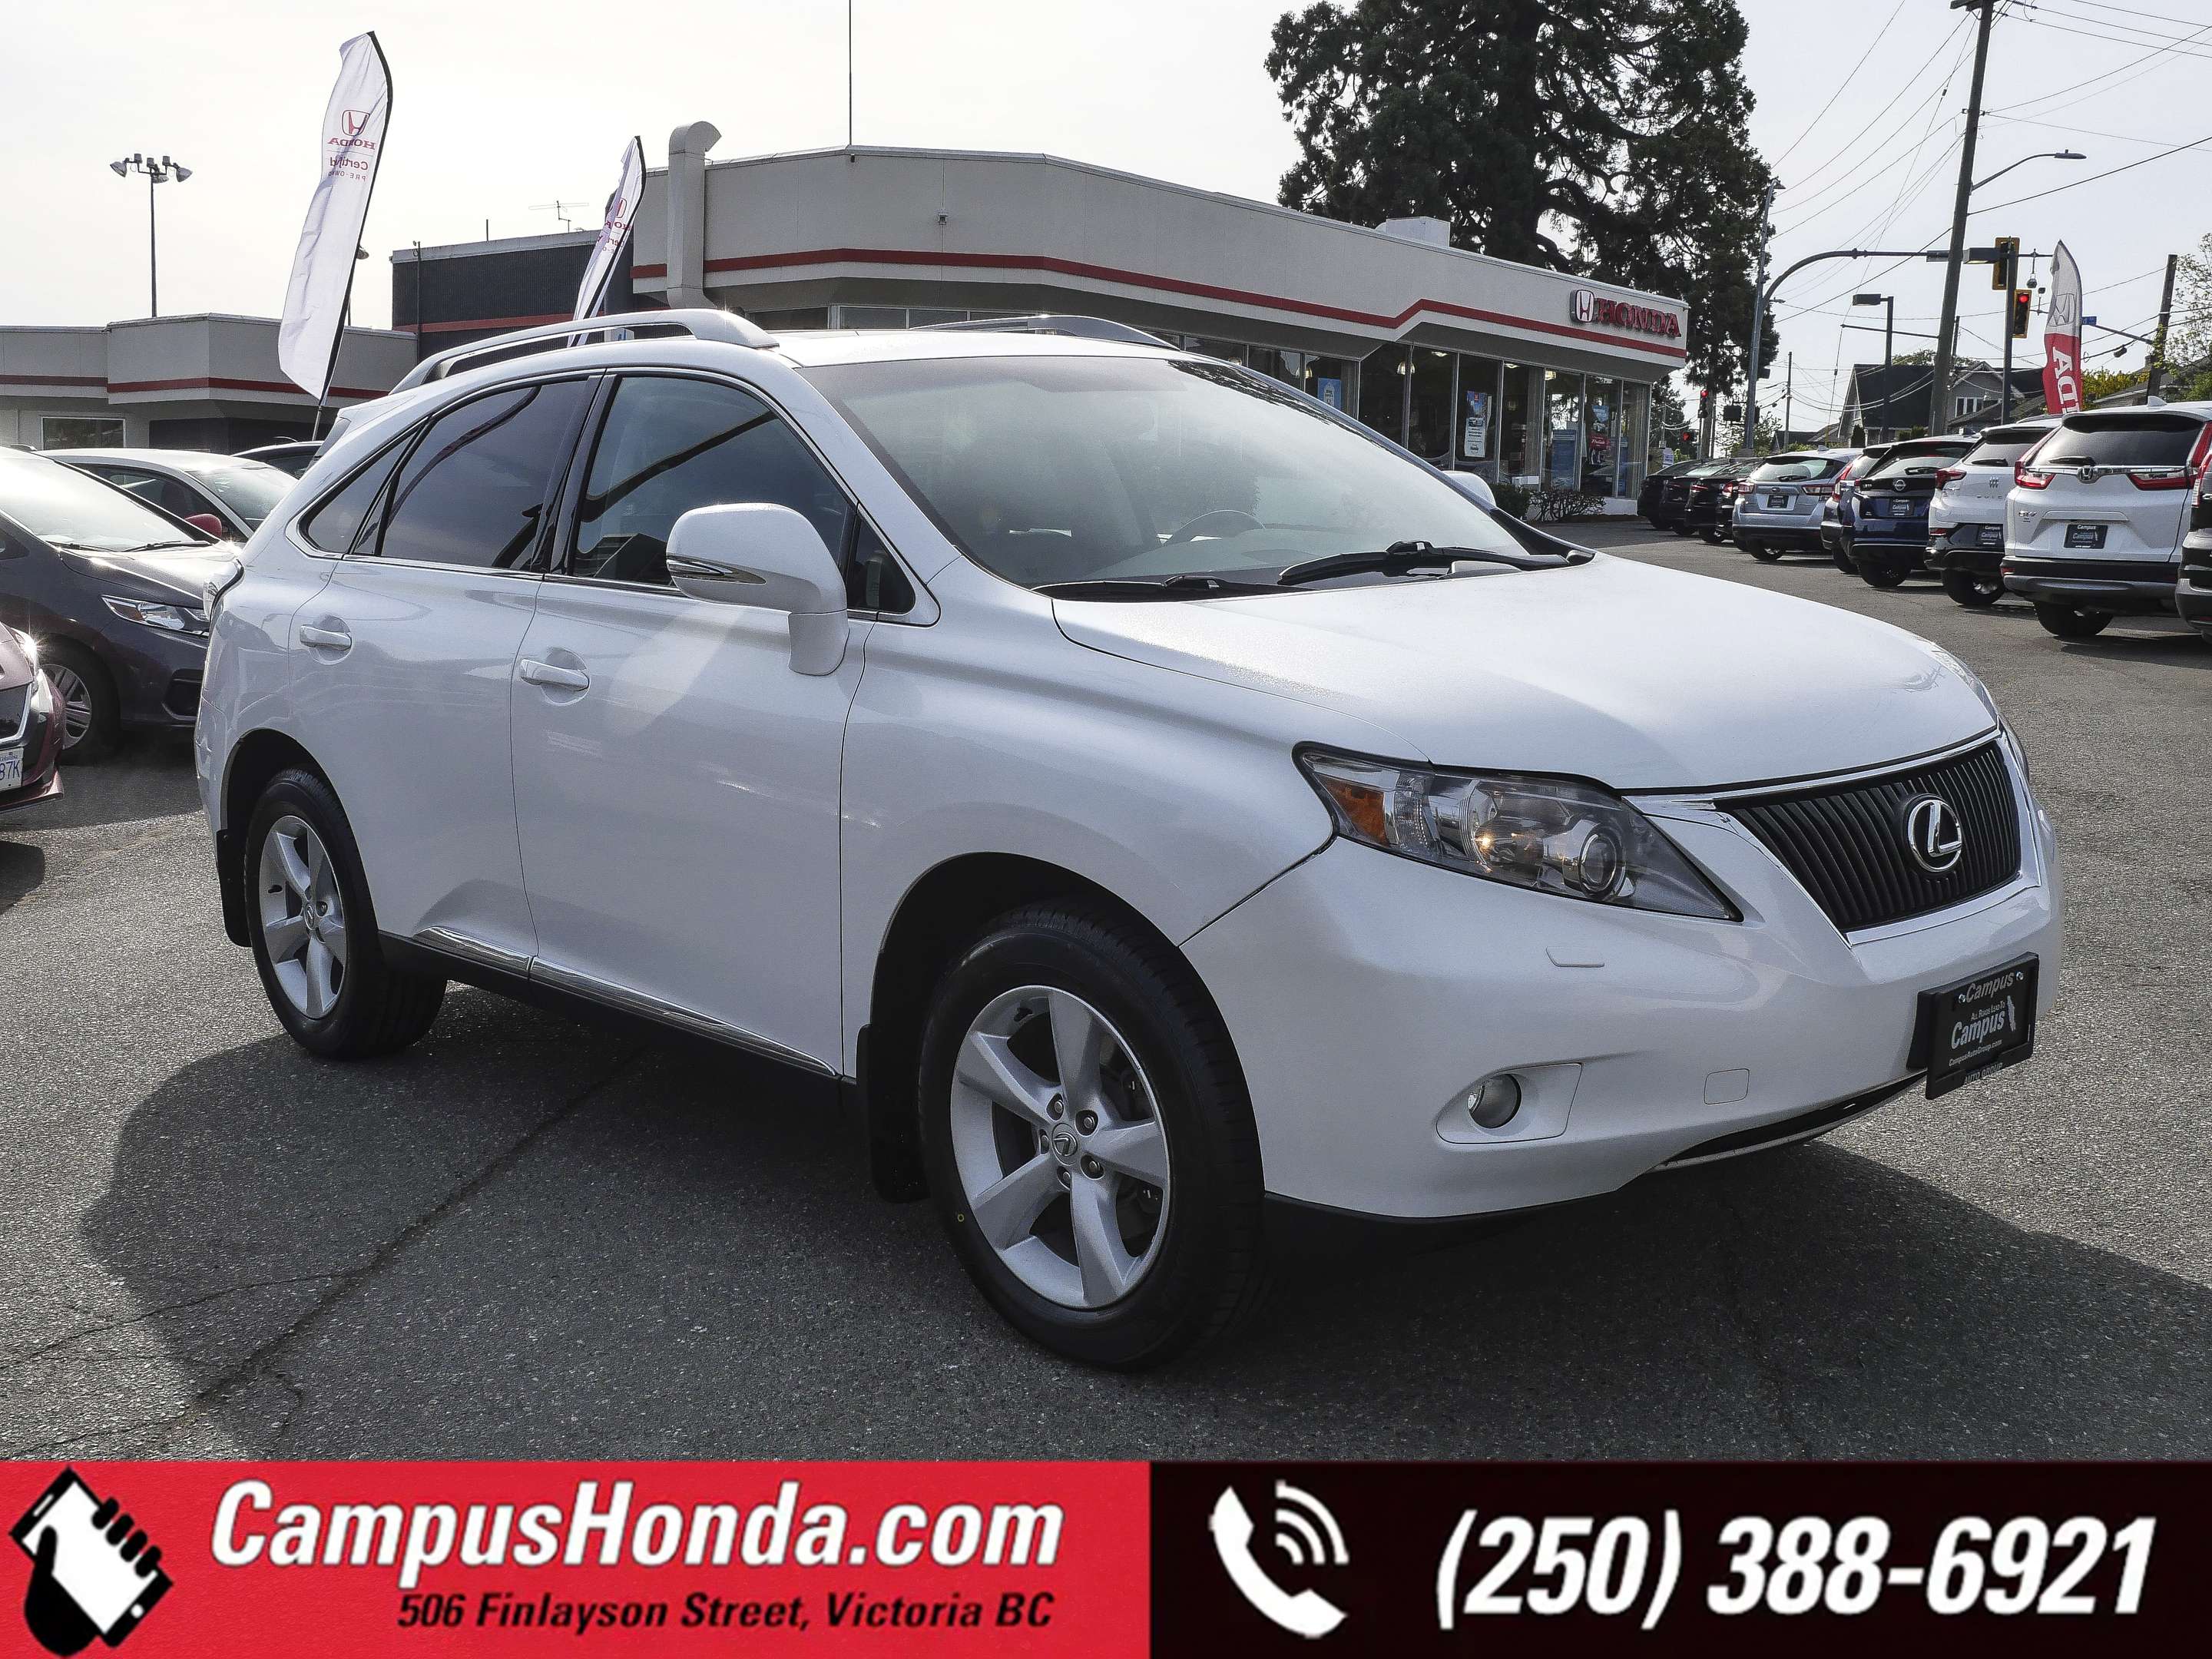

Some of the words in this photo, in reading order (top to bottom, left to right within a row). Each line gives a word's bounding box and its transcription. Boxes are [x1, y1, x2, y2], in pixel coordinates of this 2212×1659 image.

[1596, 297, 1682, 338] HONDA
[1966, 972, 2015, 1003] Campus
[1951, 1010, 2005, 1050] Campus
[1982, 1062, 2003, 1077] GROUP
